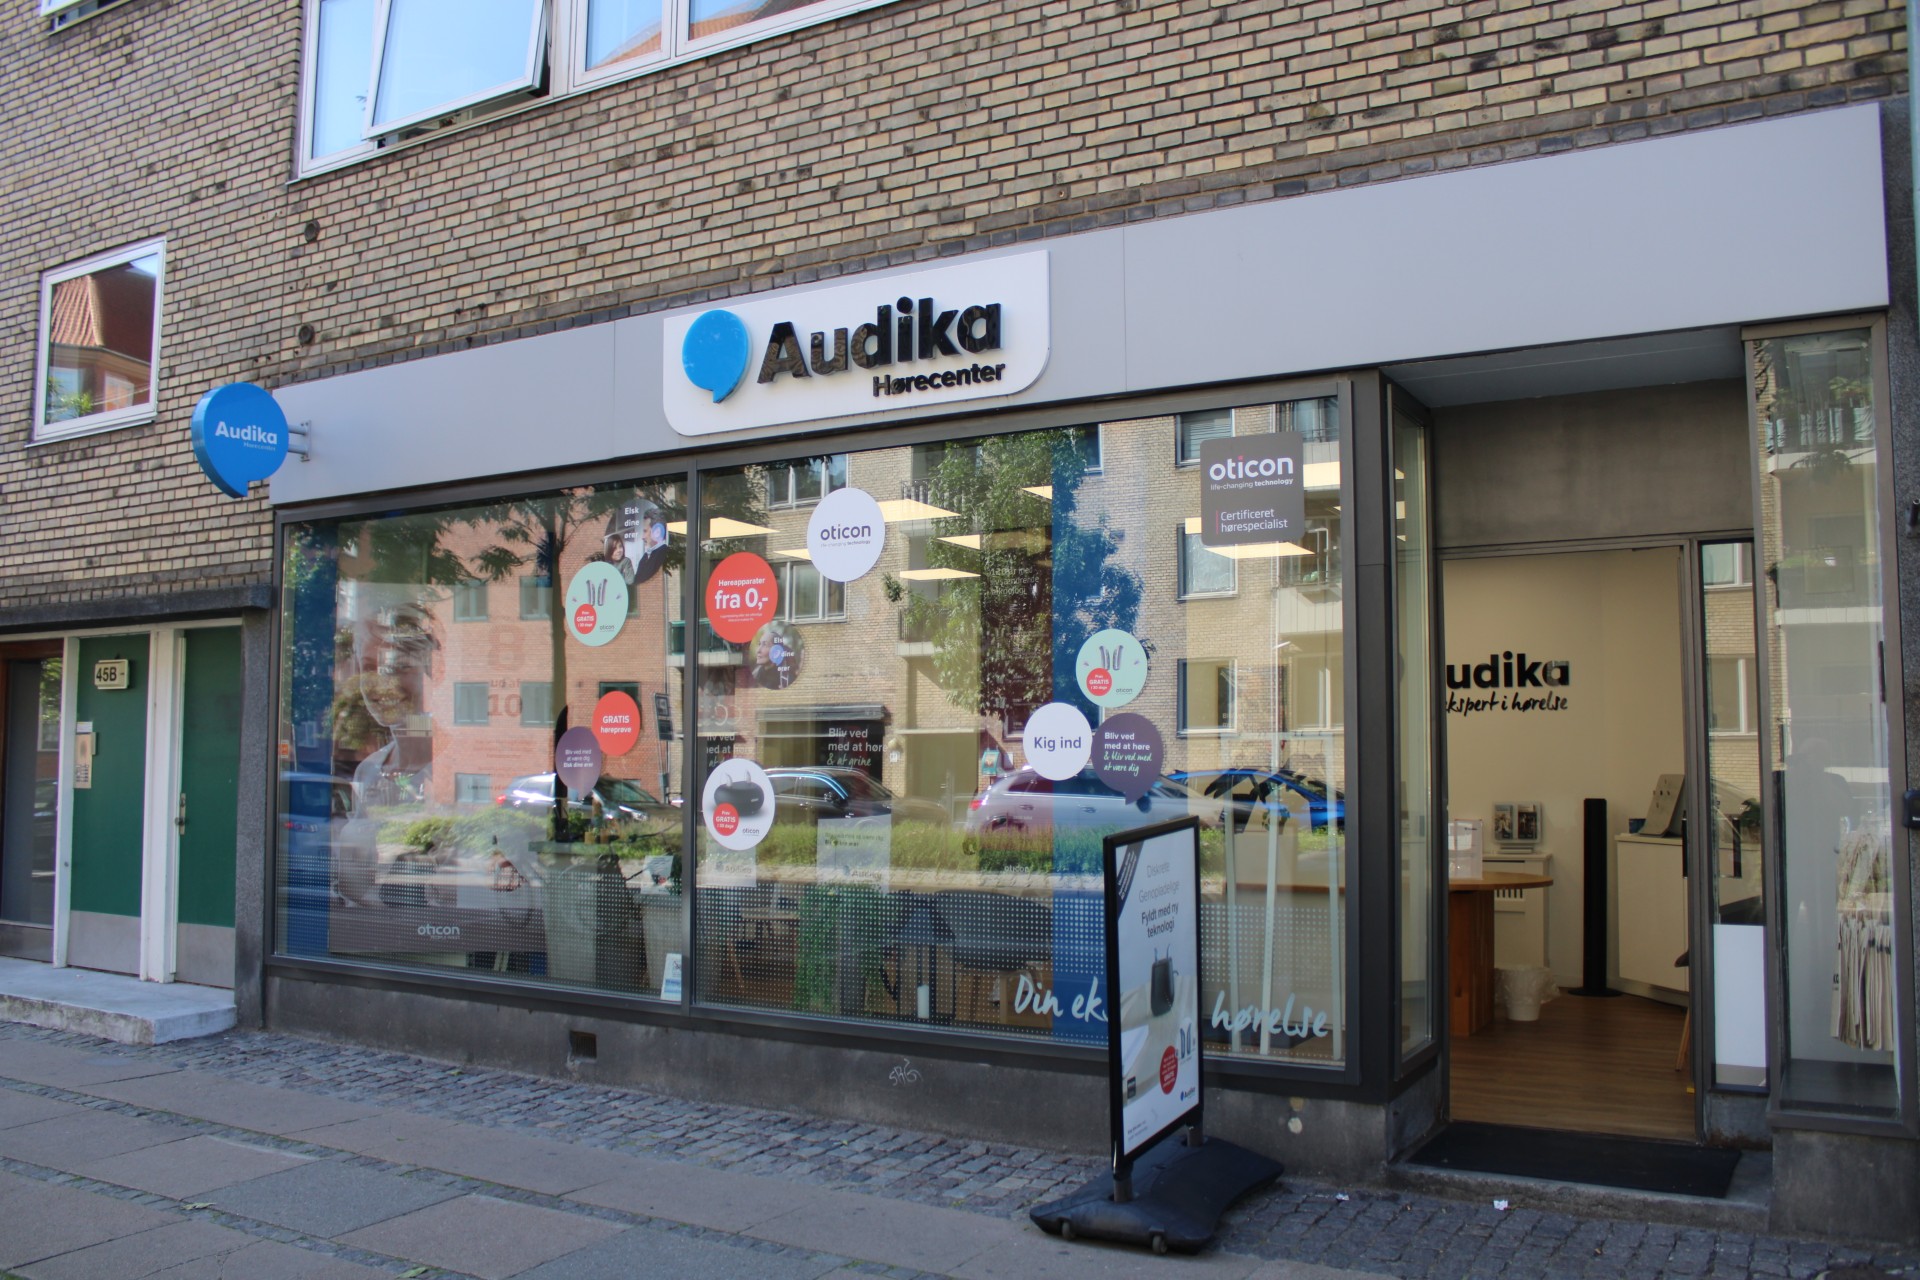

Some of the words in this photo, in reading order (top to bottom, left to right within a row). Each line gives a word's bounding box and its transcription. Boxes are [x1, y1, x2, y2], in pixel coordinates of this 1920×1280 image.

[757, 296, 1002, 384] Audika
[872, 362, 1006, 397] Hørecenter
[214, 420, 278, 445] Audika
[1209, 455, 1294, 481] oticon
[1210, 480, 1254, 491] life-changing
[1254, 478, 1294, 487] technology
[624, 507, 640, 515] Elsk
[1220, 508, 1275, 521] Certificeret
[624, 519, 640, 527] dine
[1221, 519, 1288, 533] hørespecialist
[820, 524, 871, 541] oticon
[718, 577, 766, 588] Høreapparater
[714, 589, 741, 610] fra
[744, 587, 769, 610] 0,-
[95, 666, 117, 682] 45B
[1446, 650, 1570, 690] udika
[487, 692, 524, 717] 10
[1445, 690, 1500, 717] kspert
[1501, 695, 1508, 711] i
[1511, 690, 1568, 713] hørelse
[602, 715, 630, 724] GRATIS
[600, 726, 632, 734] høreprøve
[828, 727, 848, 738] Bliv
[849, 728, 869, 738] ved
[1104, 732, 1119, 740] Bliv
[1120, 732, 1135, 740] ved
[721, 745, 731, 754] at
[828, 741, 850, 751] med
[852, 742, 863, 752] at
[865, 741, 889, 752] høre
[1034, 736, 1056, 752] Kig
[1060, 736, 1082, 749] ind
[1104, 742, 1121, 750] med
[1132, 742, 1151, 751] høre
[836, 752, 848, 766] at
[1137, 752, 1153, 762] med
[1128, 763, 1140, 777] dig
[1141, 907, 1157, 926] Fyldt
[1157, 903, 1171, 917] med
[1171, 902, 1179, 915] ny
[417, 923, 461, 936] oticon
[1147, 916, 1175, 938] teknologi
[1014, 973, 1064, 1015] Din
[1211, 989, 1329, 1039] hørelse
